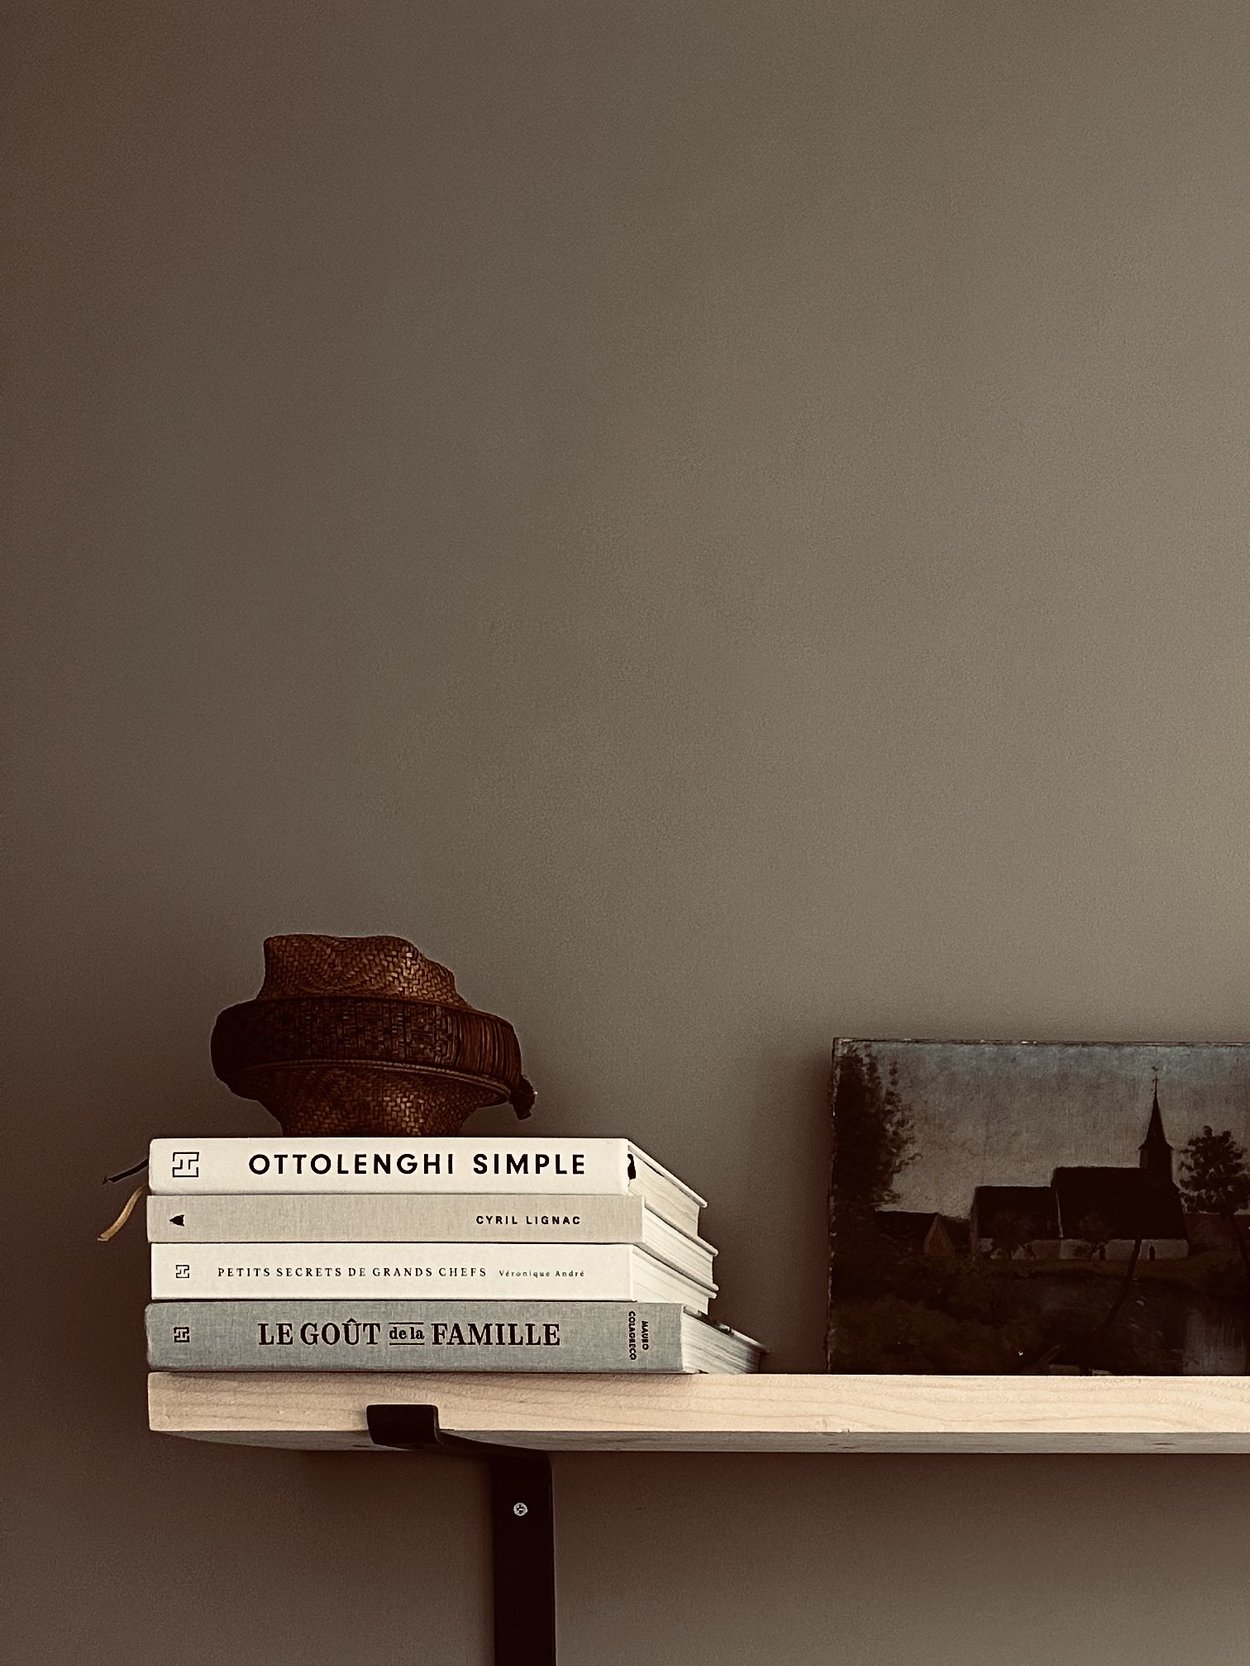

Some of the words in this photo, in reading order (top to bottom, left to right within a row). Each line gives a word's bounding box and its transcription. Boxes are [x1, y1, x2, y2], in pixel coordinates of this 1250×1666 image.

[248, 1153, 454, 1175] OTTOLENGHI
[472, 1153, 585, 1175] SIMPLE
[475, 1215, 518, 1225] CYRIL
[525, 1215, 581, 1225] LIGNAC
[217, 1267, 271, 1278] PETITS
[276, 1267, 342, 1278] SECRETS
[347, 1267, 366, 1277] DE
[372, 1267, 433, 1278] GRANDS
[438, 1267, 487, 1277] CHEFS
[498, 1269, 551, 1279] Véronique
[554, 1269, 585, 1278] André
[257, 1322, 294, 1346] LE
[299, 1317, 381, 1346] GOÛT
[388, 1325, 408, 1341] de
[408, 1325, 426, 1341] la
[431, 1322, 561, 1347] FAMILLE
[641, 1320, 650, 1351] MAURO
